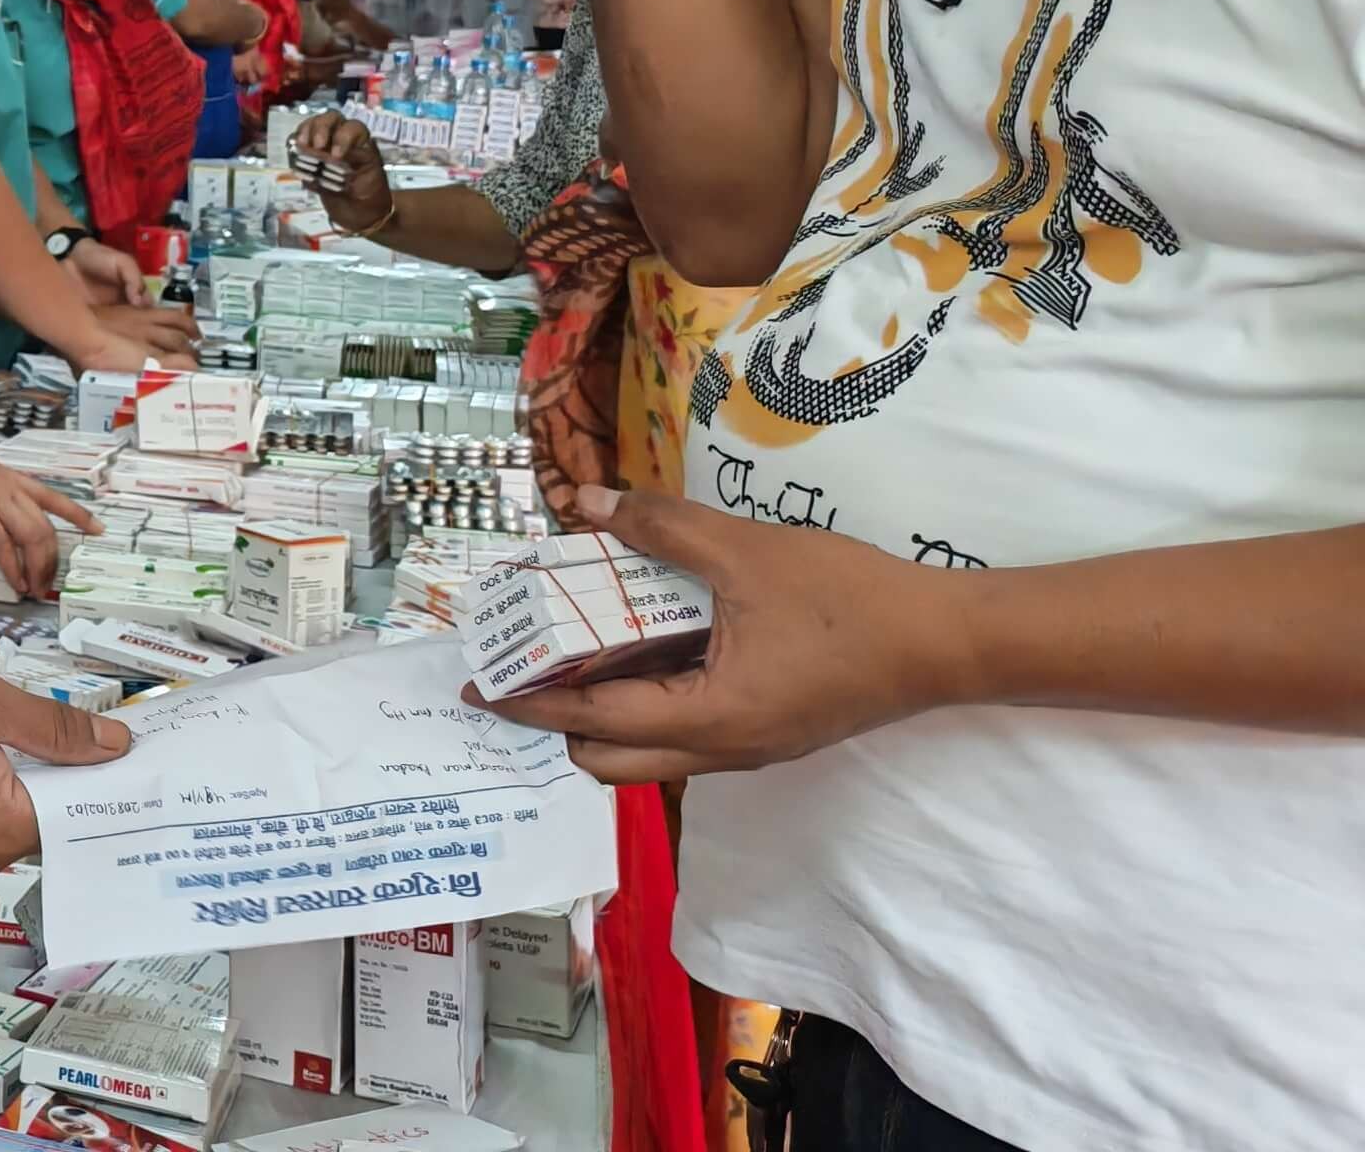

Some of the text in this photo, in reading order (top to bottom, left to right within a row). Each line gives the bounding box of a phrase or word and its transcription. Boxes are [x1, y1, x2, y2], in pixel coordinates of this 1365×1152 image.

[651, 604, 703, 625] HEPOXY
[489, 643, 550, 688] HEPOXY 300
